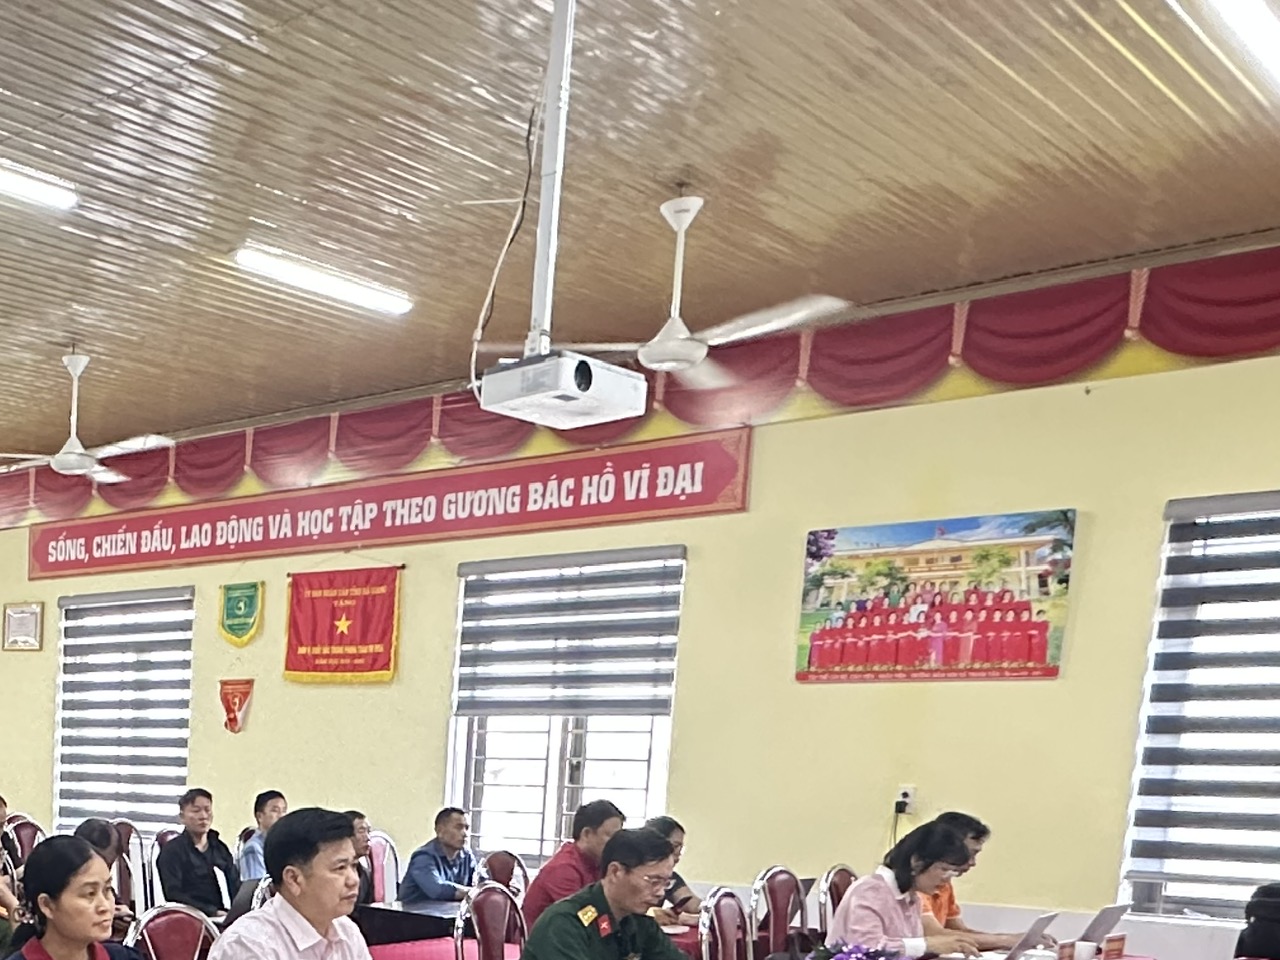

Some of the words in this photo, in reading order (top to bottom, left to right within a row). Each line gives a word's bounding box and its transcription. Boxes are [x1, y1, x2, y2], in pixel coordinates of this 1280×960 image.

[48, 529, 89, 563] SỐNG,
[93, 525, 137, 557] CHIẾN
[140, 520, 175, 554] ĐẤU,
[180, 523, 212, 549] LAO
[216, 515, 263, 548] ĐỘNG
[269, 509, 292, 540] VÀ
[297, 507, 333, 539] HỌC
[339, 499, 378, 536] TẬP
[383, 495, 437, 527] THEO
[442, 484, 521, 520] GƯƠNG
[527, 474, 575, 511] BÁC
[580, 462, 615, 506] HỒ
[623, 464, 651, 501] VĨ
[656, 462, 704, 500] ĐẠI
